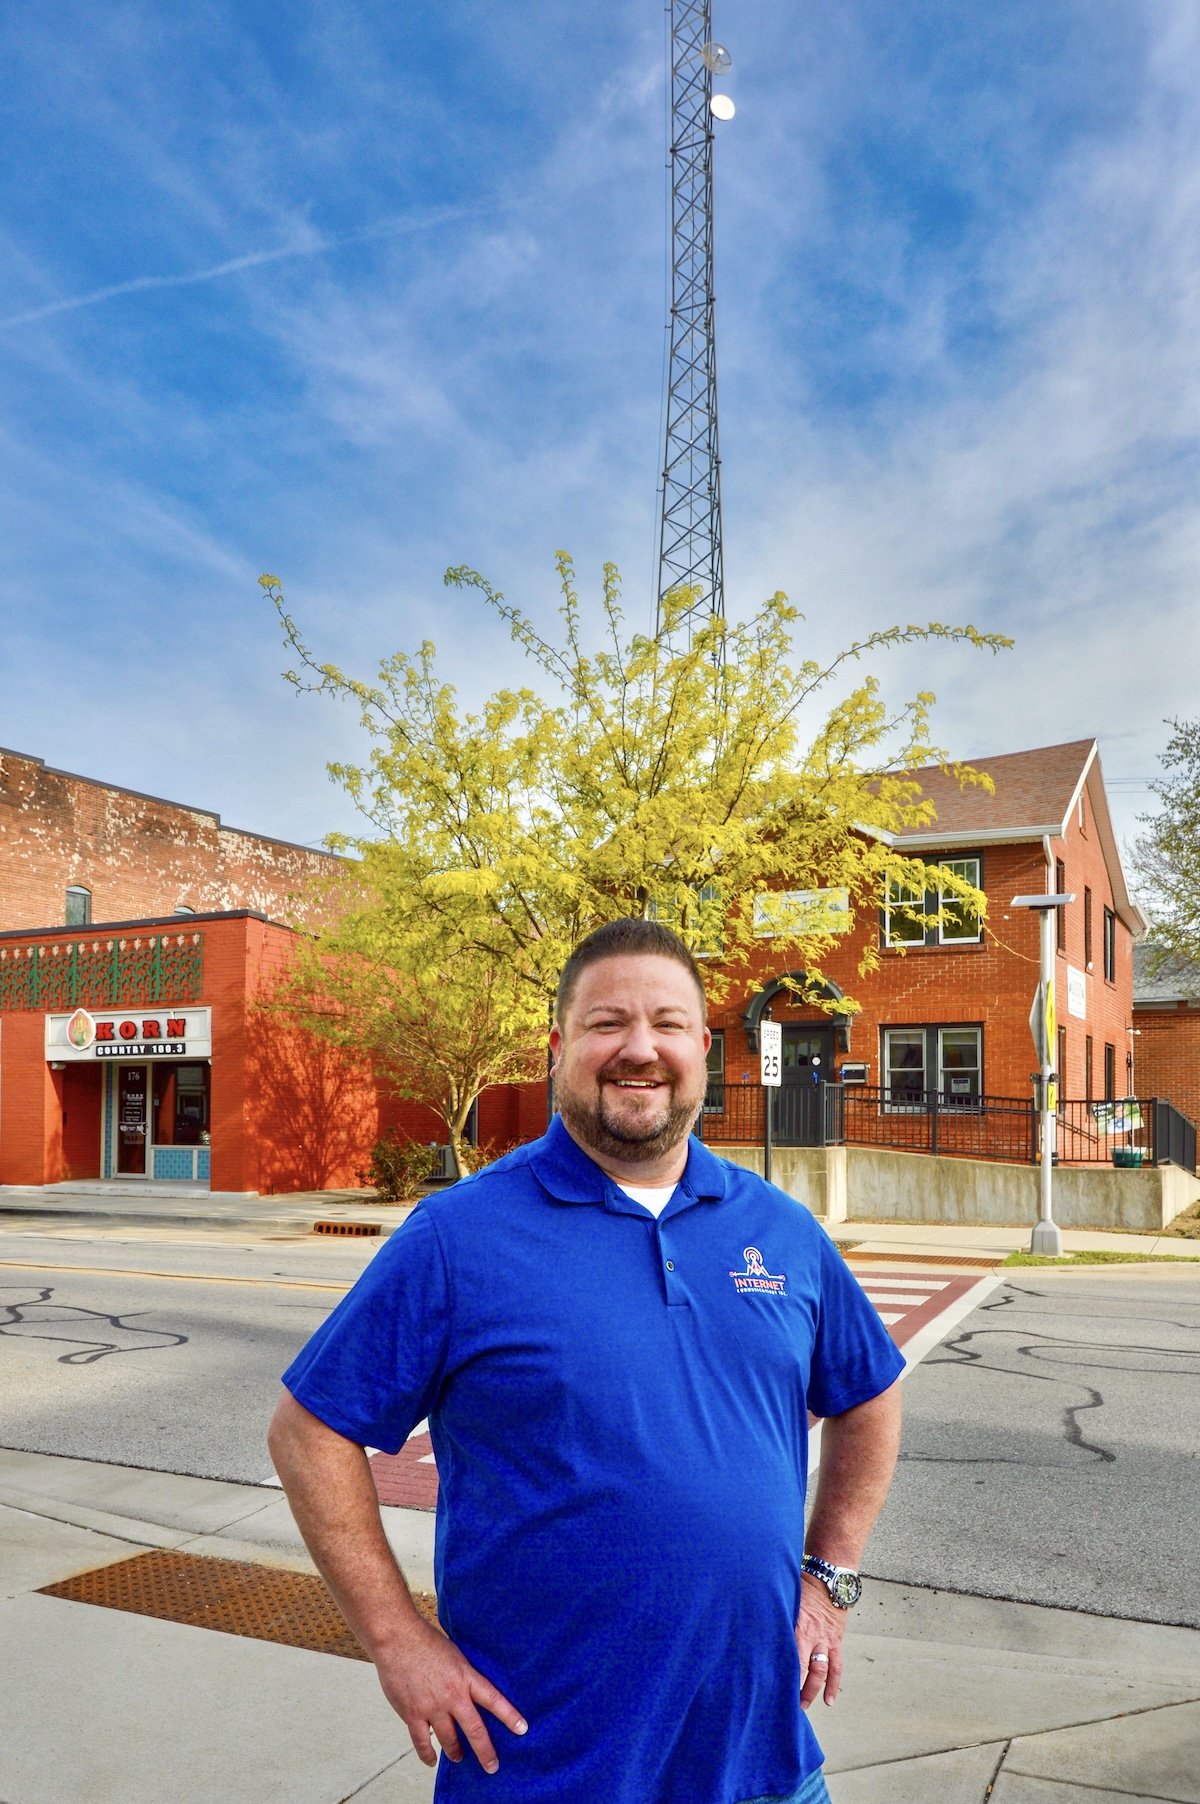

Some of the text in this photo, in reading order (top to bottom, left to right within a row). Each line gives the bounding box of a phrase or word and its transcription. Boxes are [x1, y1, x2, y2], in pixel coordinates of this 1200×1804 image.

[96, 1019, 185, 1040] KORN
[763, 1029, 779, 1040] SPEED
[97, 1044, 183, 1055] COUNTRY 100.3
[764, 1055, 779, 1077] 25
[127, 1072, 140, 1081] 176
[734, 1278, 784, 1291] INTERNET
